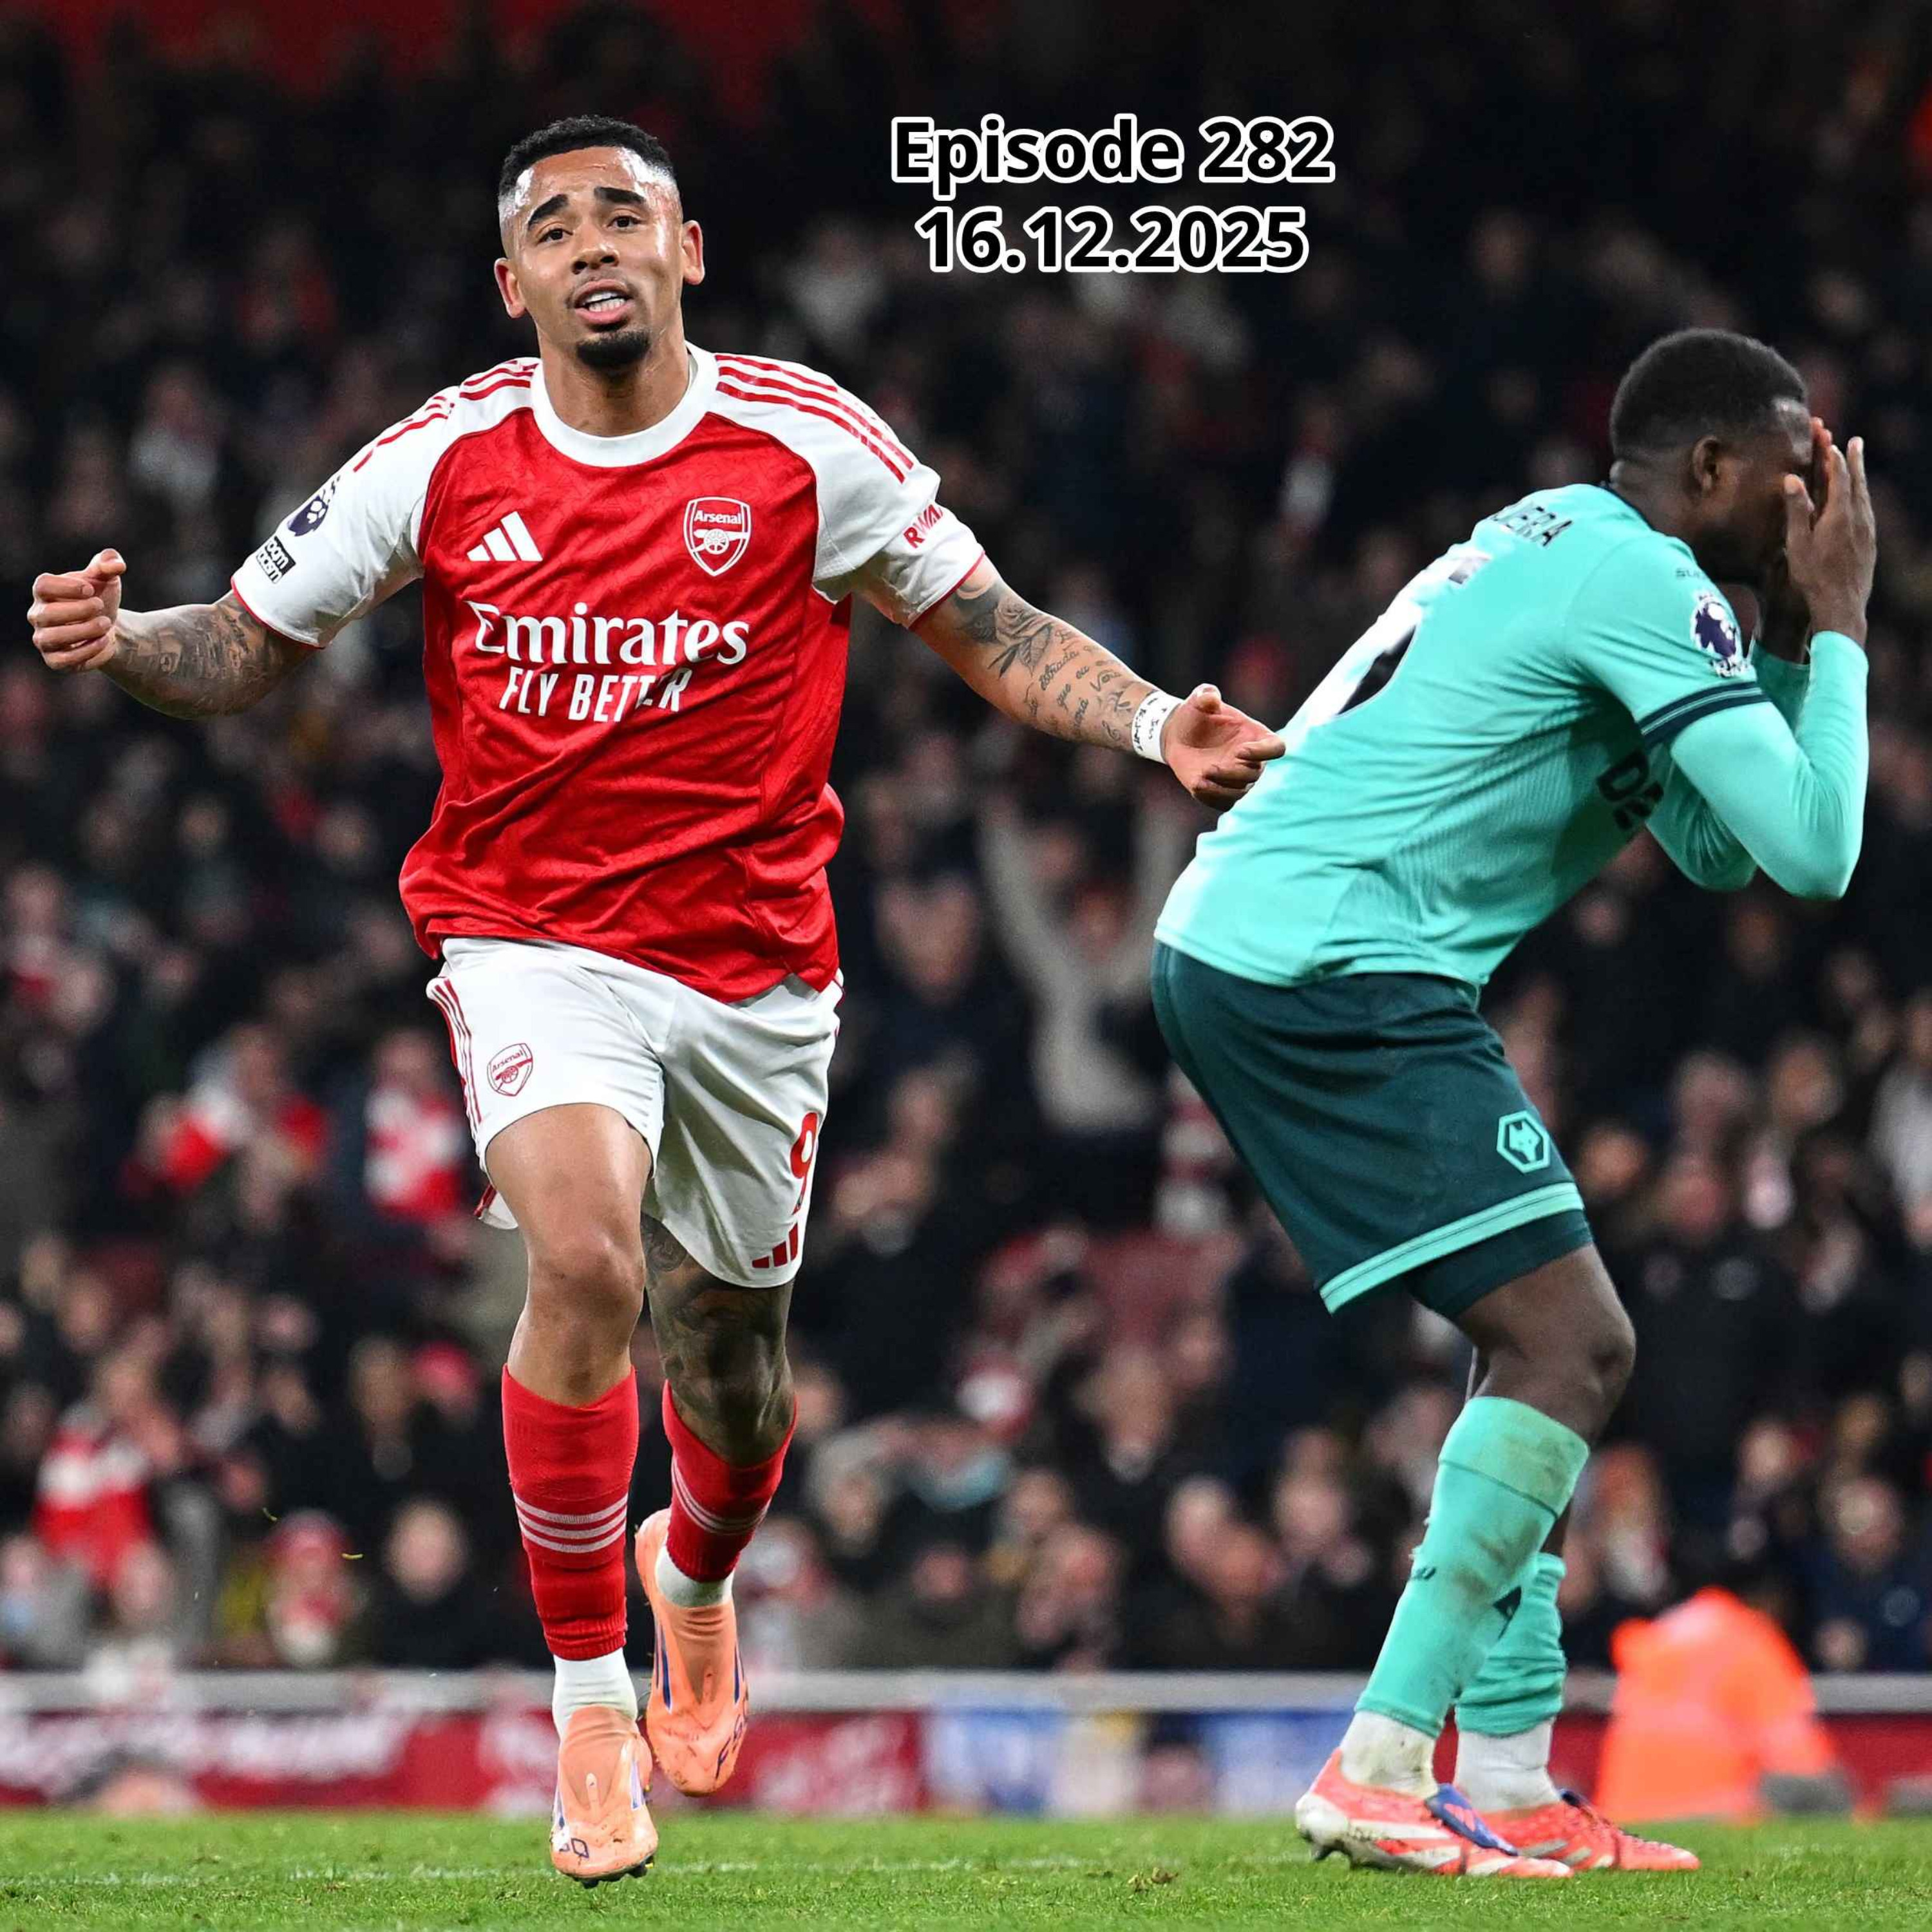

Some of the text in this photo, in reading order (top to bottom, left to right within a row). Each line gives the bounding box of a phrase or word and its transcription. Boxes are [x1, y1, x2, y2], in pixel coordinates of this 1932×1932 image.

[694, 510, 741, 524] Arsenal
[904, 504, 943, 549] RWA
[462, 600, 749, 665] Emirates
[499, 666, 558, 716] FLY
[492, 1050, 524, 1072] Arsenal
[790, 1112, 819, 1216] 9
